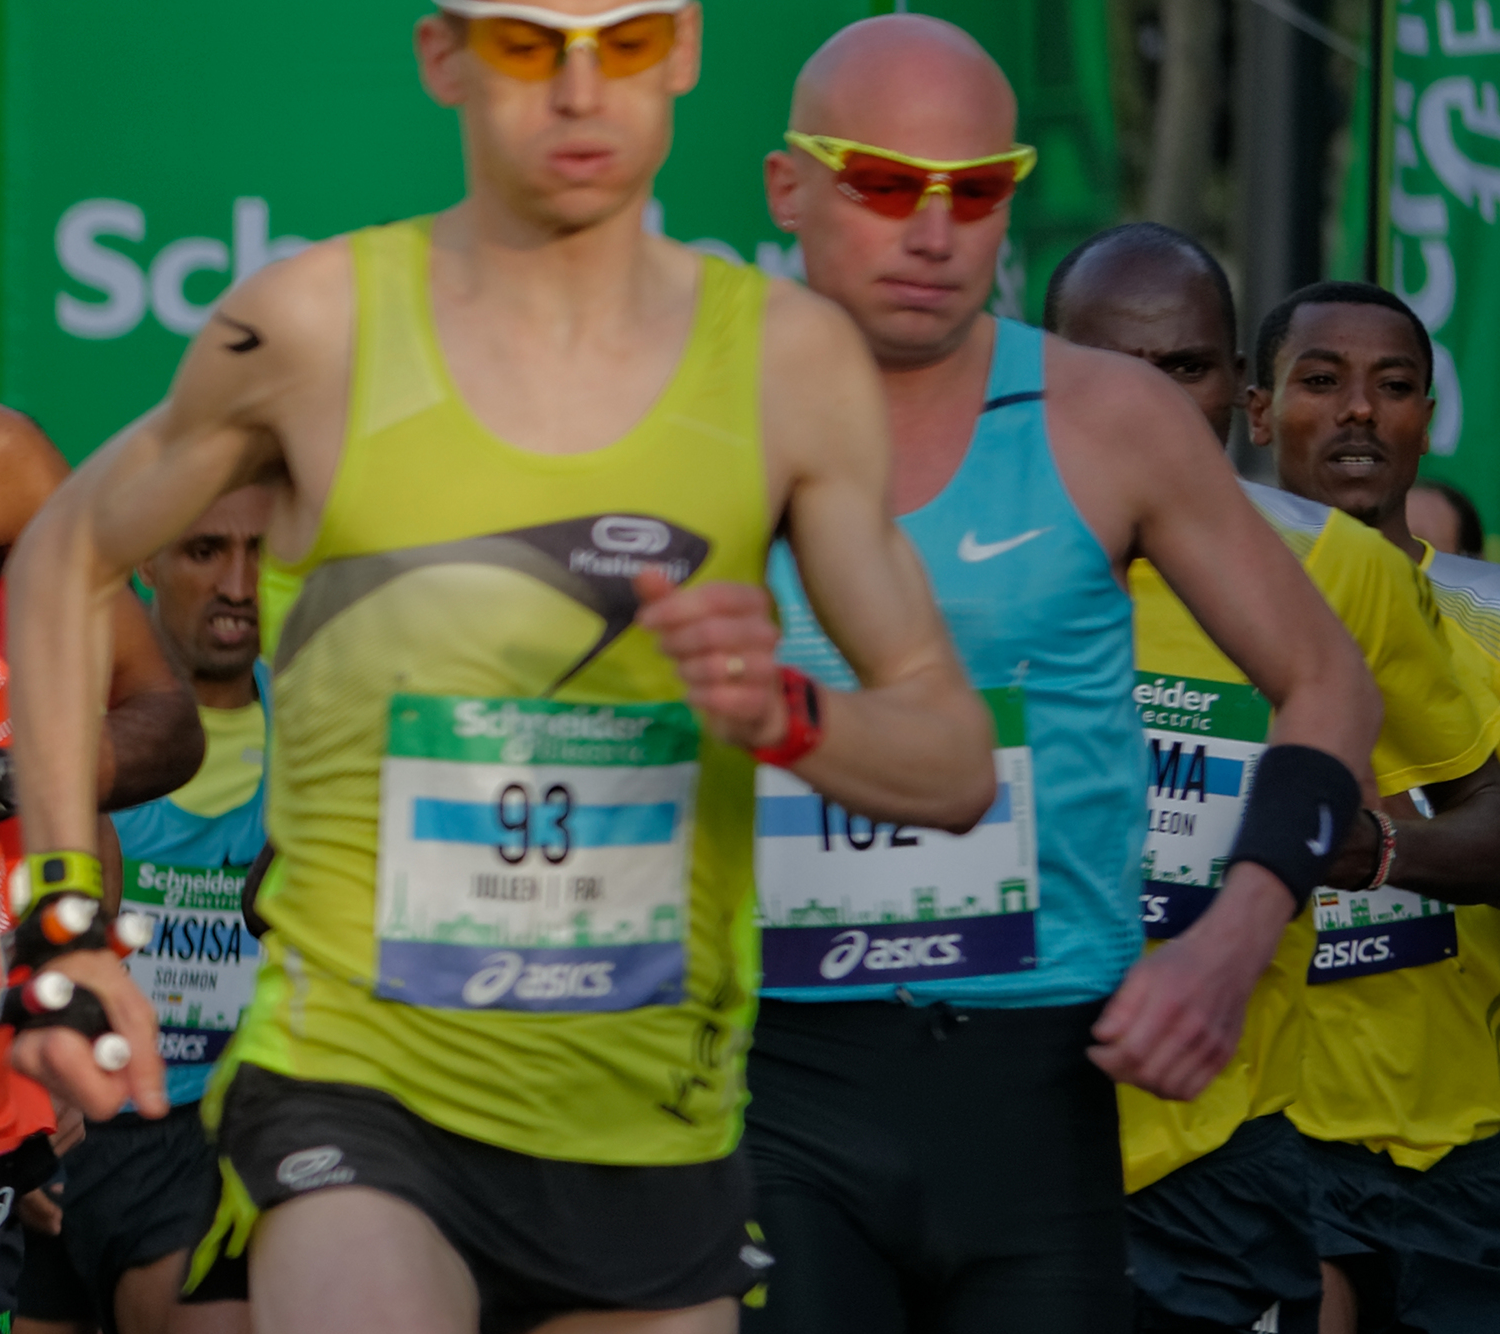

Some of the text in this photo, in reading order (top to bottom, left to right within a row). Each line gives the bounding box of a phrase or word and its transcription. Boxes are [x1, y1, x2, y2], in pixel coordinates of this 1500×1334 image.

[453, 701, 652, 738] Schneider
[1136, 706, 1212, 730] ectric
[499, 783, 571, 864] 93
[137, 863, 246, 895] Schneider
[863, 934, 962, 970] asics
[1314, 935, 1390, 969] asics
[155, 966, 218, 991] SOLOMON
[513, 961, 616, 1000] asics
